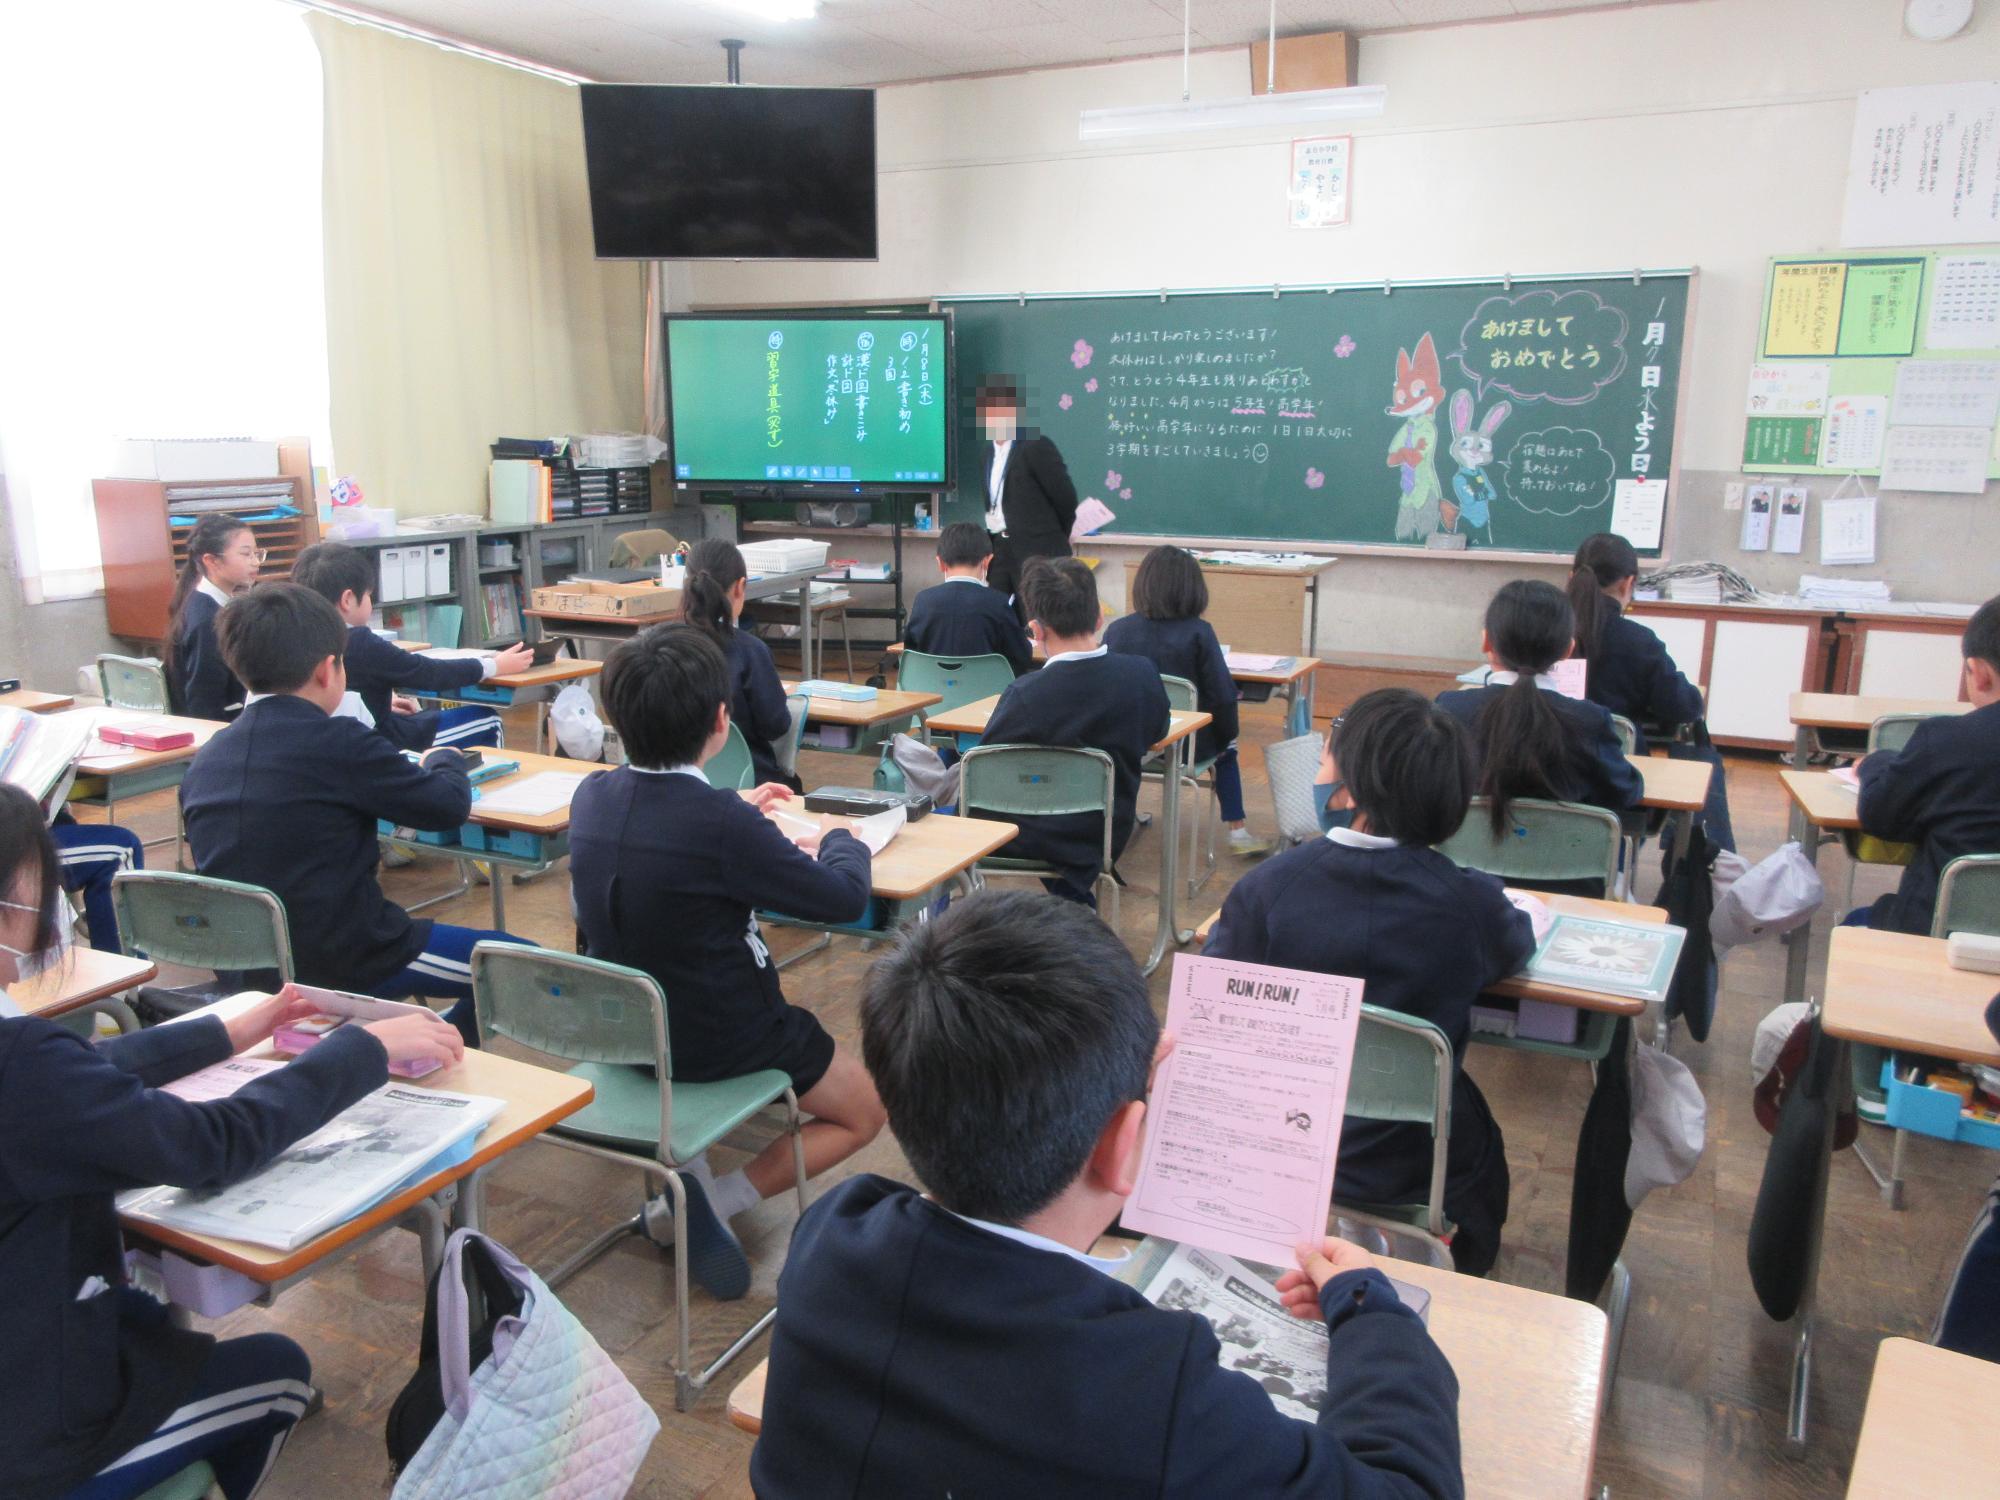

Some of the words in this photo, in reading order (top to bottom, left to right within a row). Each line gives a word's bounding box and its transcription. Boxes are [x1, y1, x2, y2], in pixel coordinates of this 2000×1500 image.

[1480, 316, 1575, 340] あけまして
[1490, 343, 1602, 370] おめでとう
